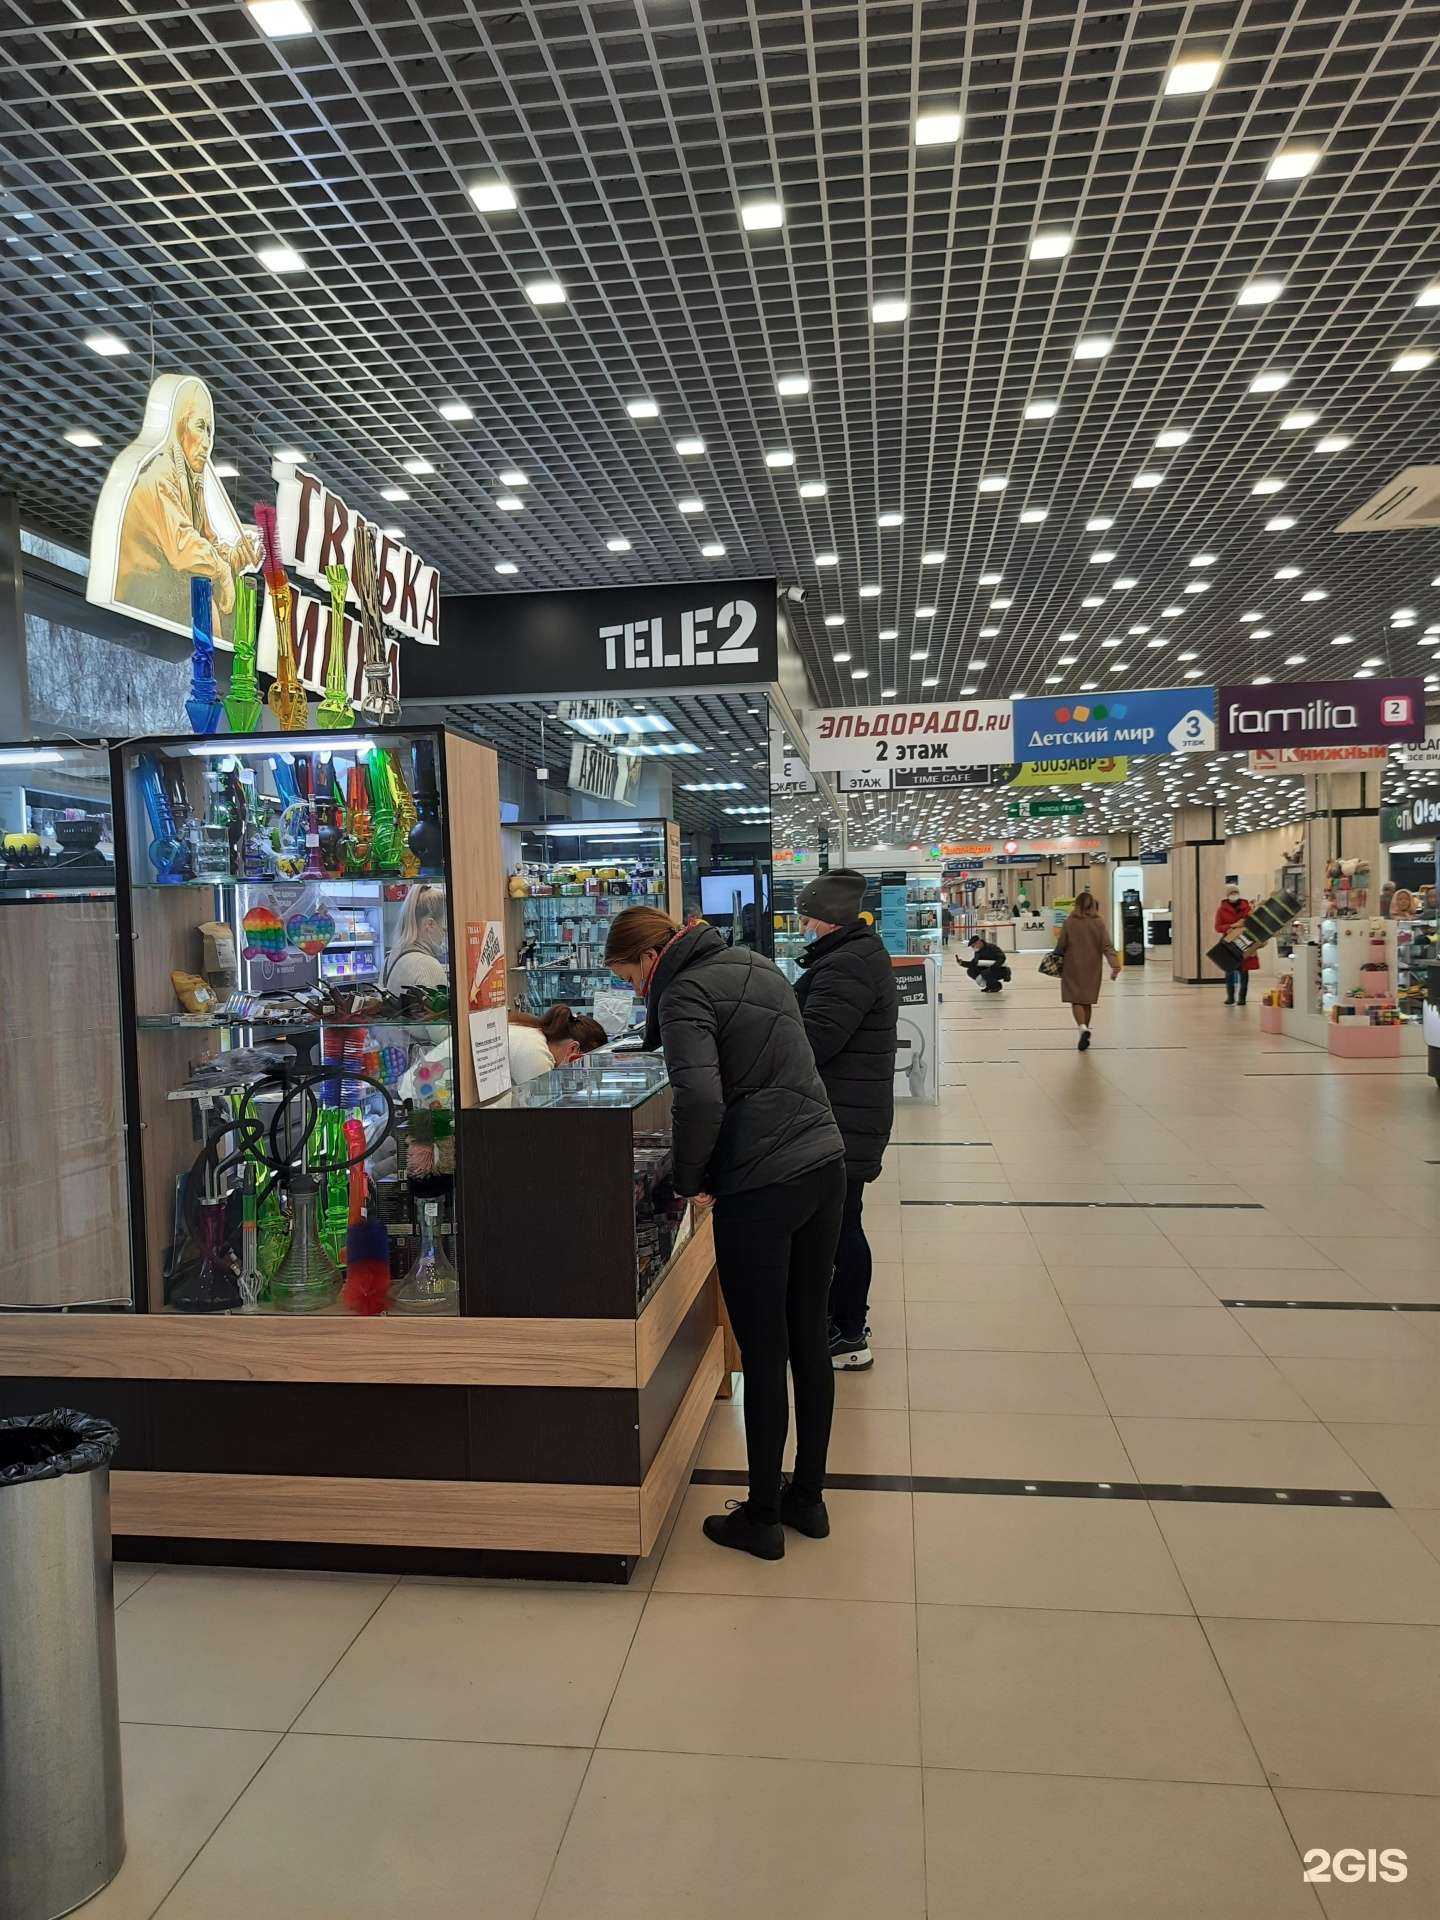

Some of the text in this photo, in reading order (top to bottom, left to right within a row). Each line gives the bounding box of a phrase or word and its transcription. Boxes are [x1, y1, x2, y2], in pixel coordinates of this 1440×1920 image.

[599, 600, 759, 670] TELE2
[1228, 699, 1358, 734] familia
[1390, 702, 1400, 714] 2
[816, 709, 1011, 739] ЭЛЬДОРАДО.RU
[1186, 716, 1200, 737] 3
[1028, 726, 1155, 747] Детский мир
[875, 740, 949, 762] 2 этаж
[850, 778, 882, 788] ЭТАЖ
[912, 773, 971, 784] TIME CAFE
[902, 992, 925, 1002] TELE2
